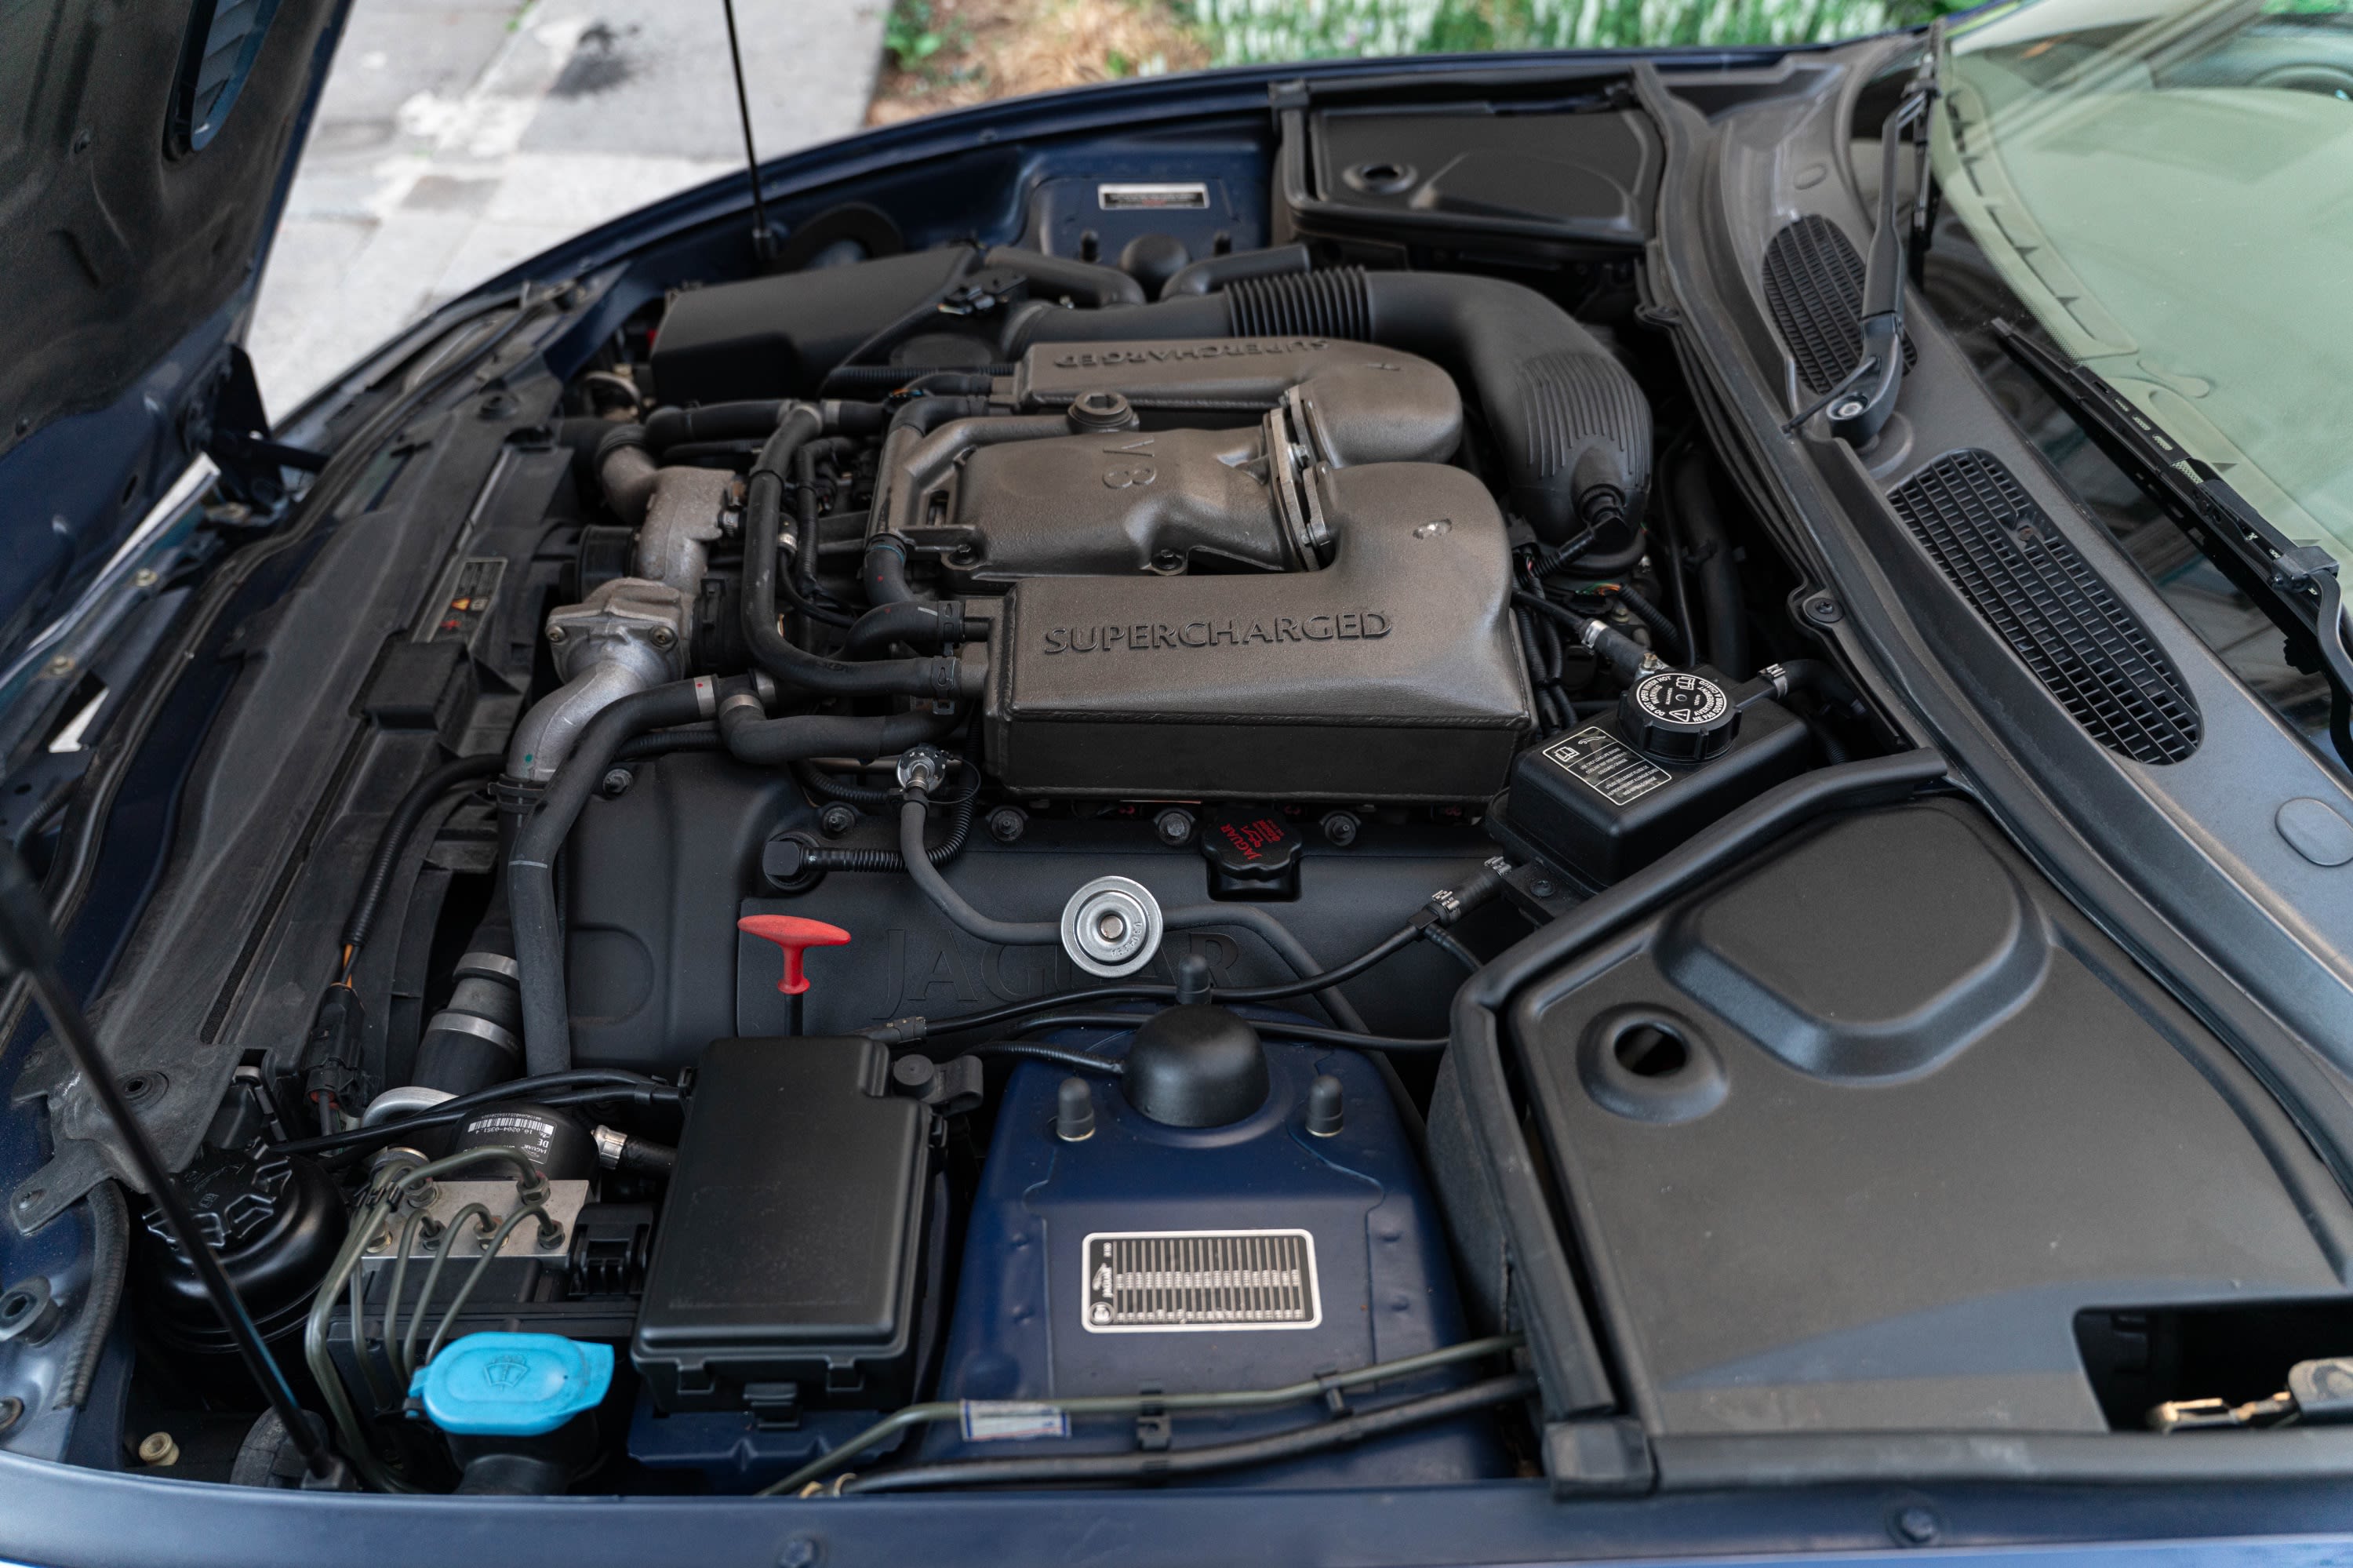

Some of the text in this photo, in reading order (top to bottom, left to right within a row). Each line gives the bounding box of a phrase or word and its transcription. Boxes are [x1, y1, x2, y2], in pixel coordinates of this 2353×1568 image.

[1055, 339, 1330, 368] SUPERCHARGED
[1101, 435, 1157, 489] V8
[1045, 609, 1391, 654] SUPERCHARGED
[1640, 689, 1649, 701] OPEN
[1644, 702, 1657, 711] NOT
[1649, 685, 1663, 704] WARNING
[1220, 823, 1262, 860] JAGUAR
[537, 1138, 549, 1148] DE
